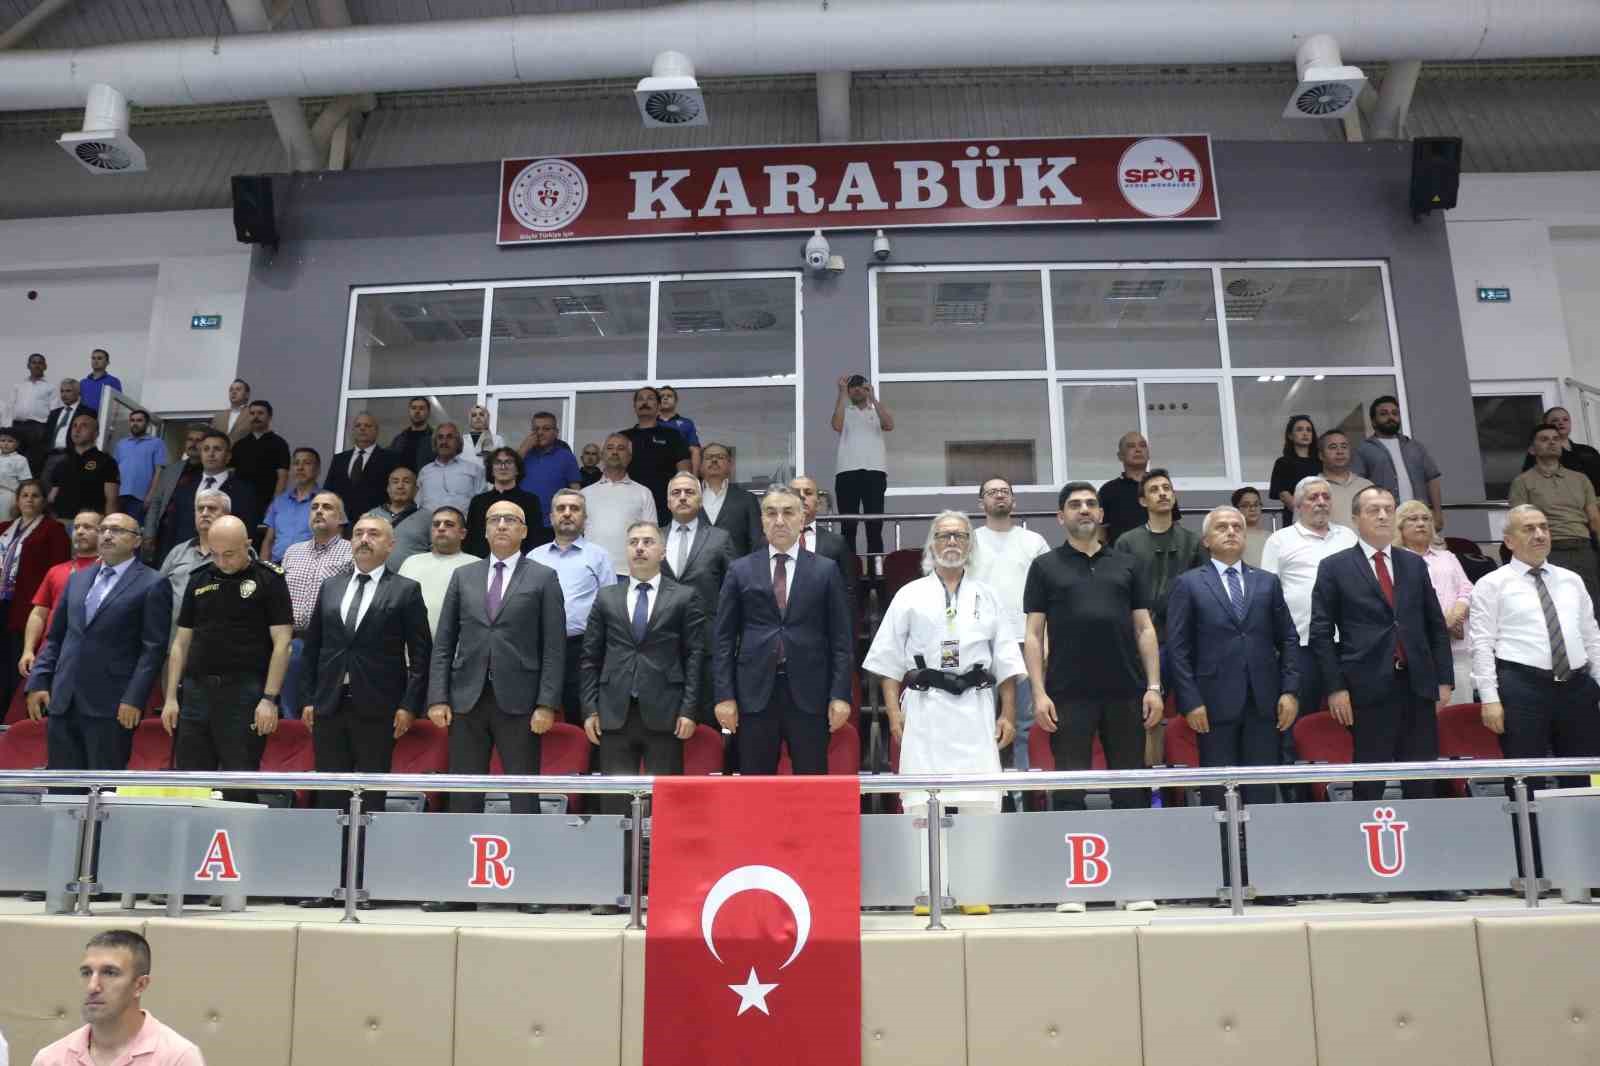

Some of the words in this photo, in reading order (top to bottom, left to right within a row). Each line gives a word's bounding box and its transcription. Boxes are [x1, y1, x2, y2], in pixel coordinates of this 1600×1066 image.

[627, 145, 1083, 220] KARABÜK
[1124, 167, 1196, 183] SPOR
[196, 831, 241, 881] A
[470, 835, 514, 888] R
[1066, 833, 1111, 888] B
[1362, 808, 1408, 877] Ü
